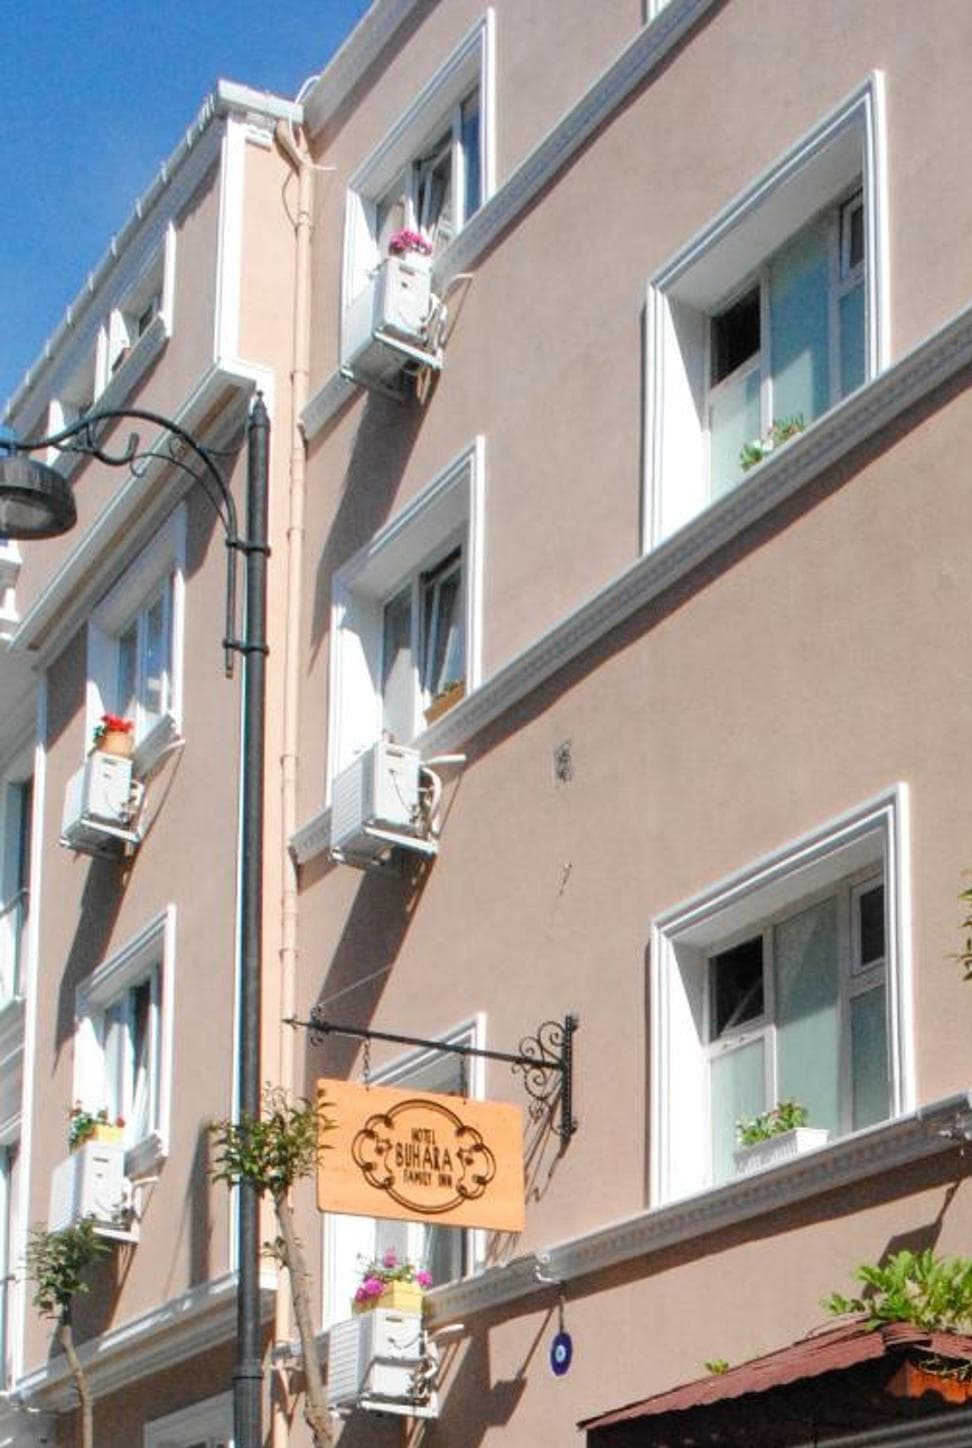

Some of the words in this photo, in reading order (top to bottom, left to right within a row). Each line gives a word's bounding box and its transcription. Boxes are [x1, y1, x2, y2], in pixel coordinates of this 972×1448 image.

[411, 1127, 436, 1145] HOTEL
[395, 1142, 454, 1171] BUHARA
[403, 1169, 432, 1186] FAMILY
[438, 1172, 453, 1188] INN
